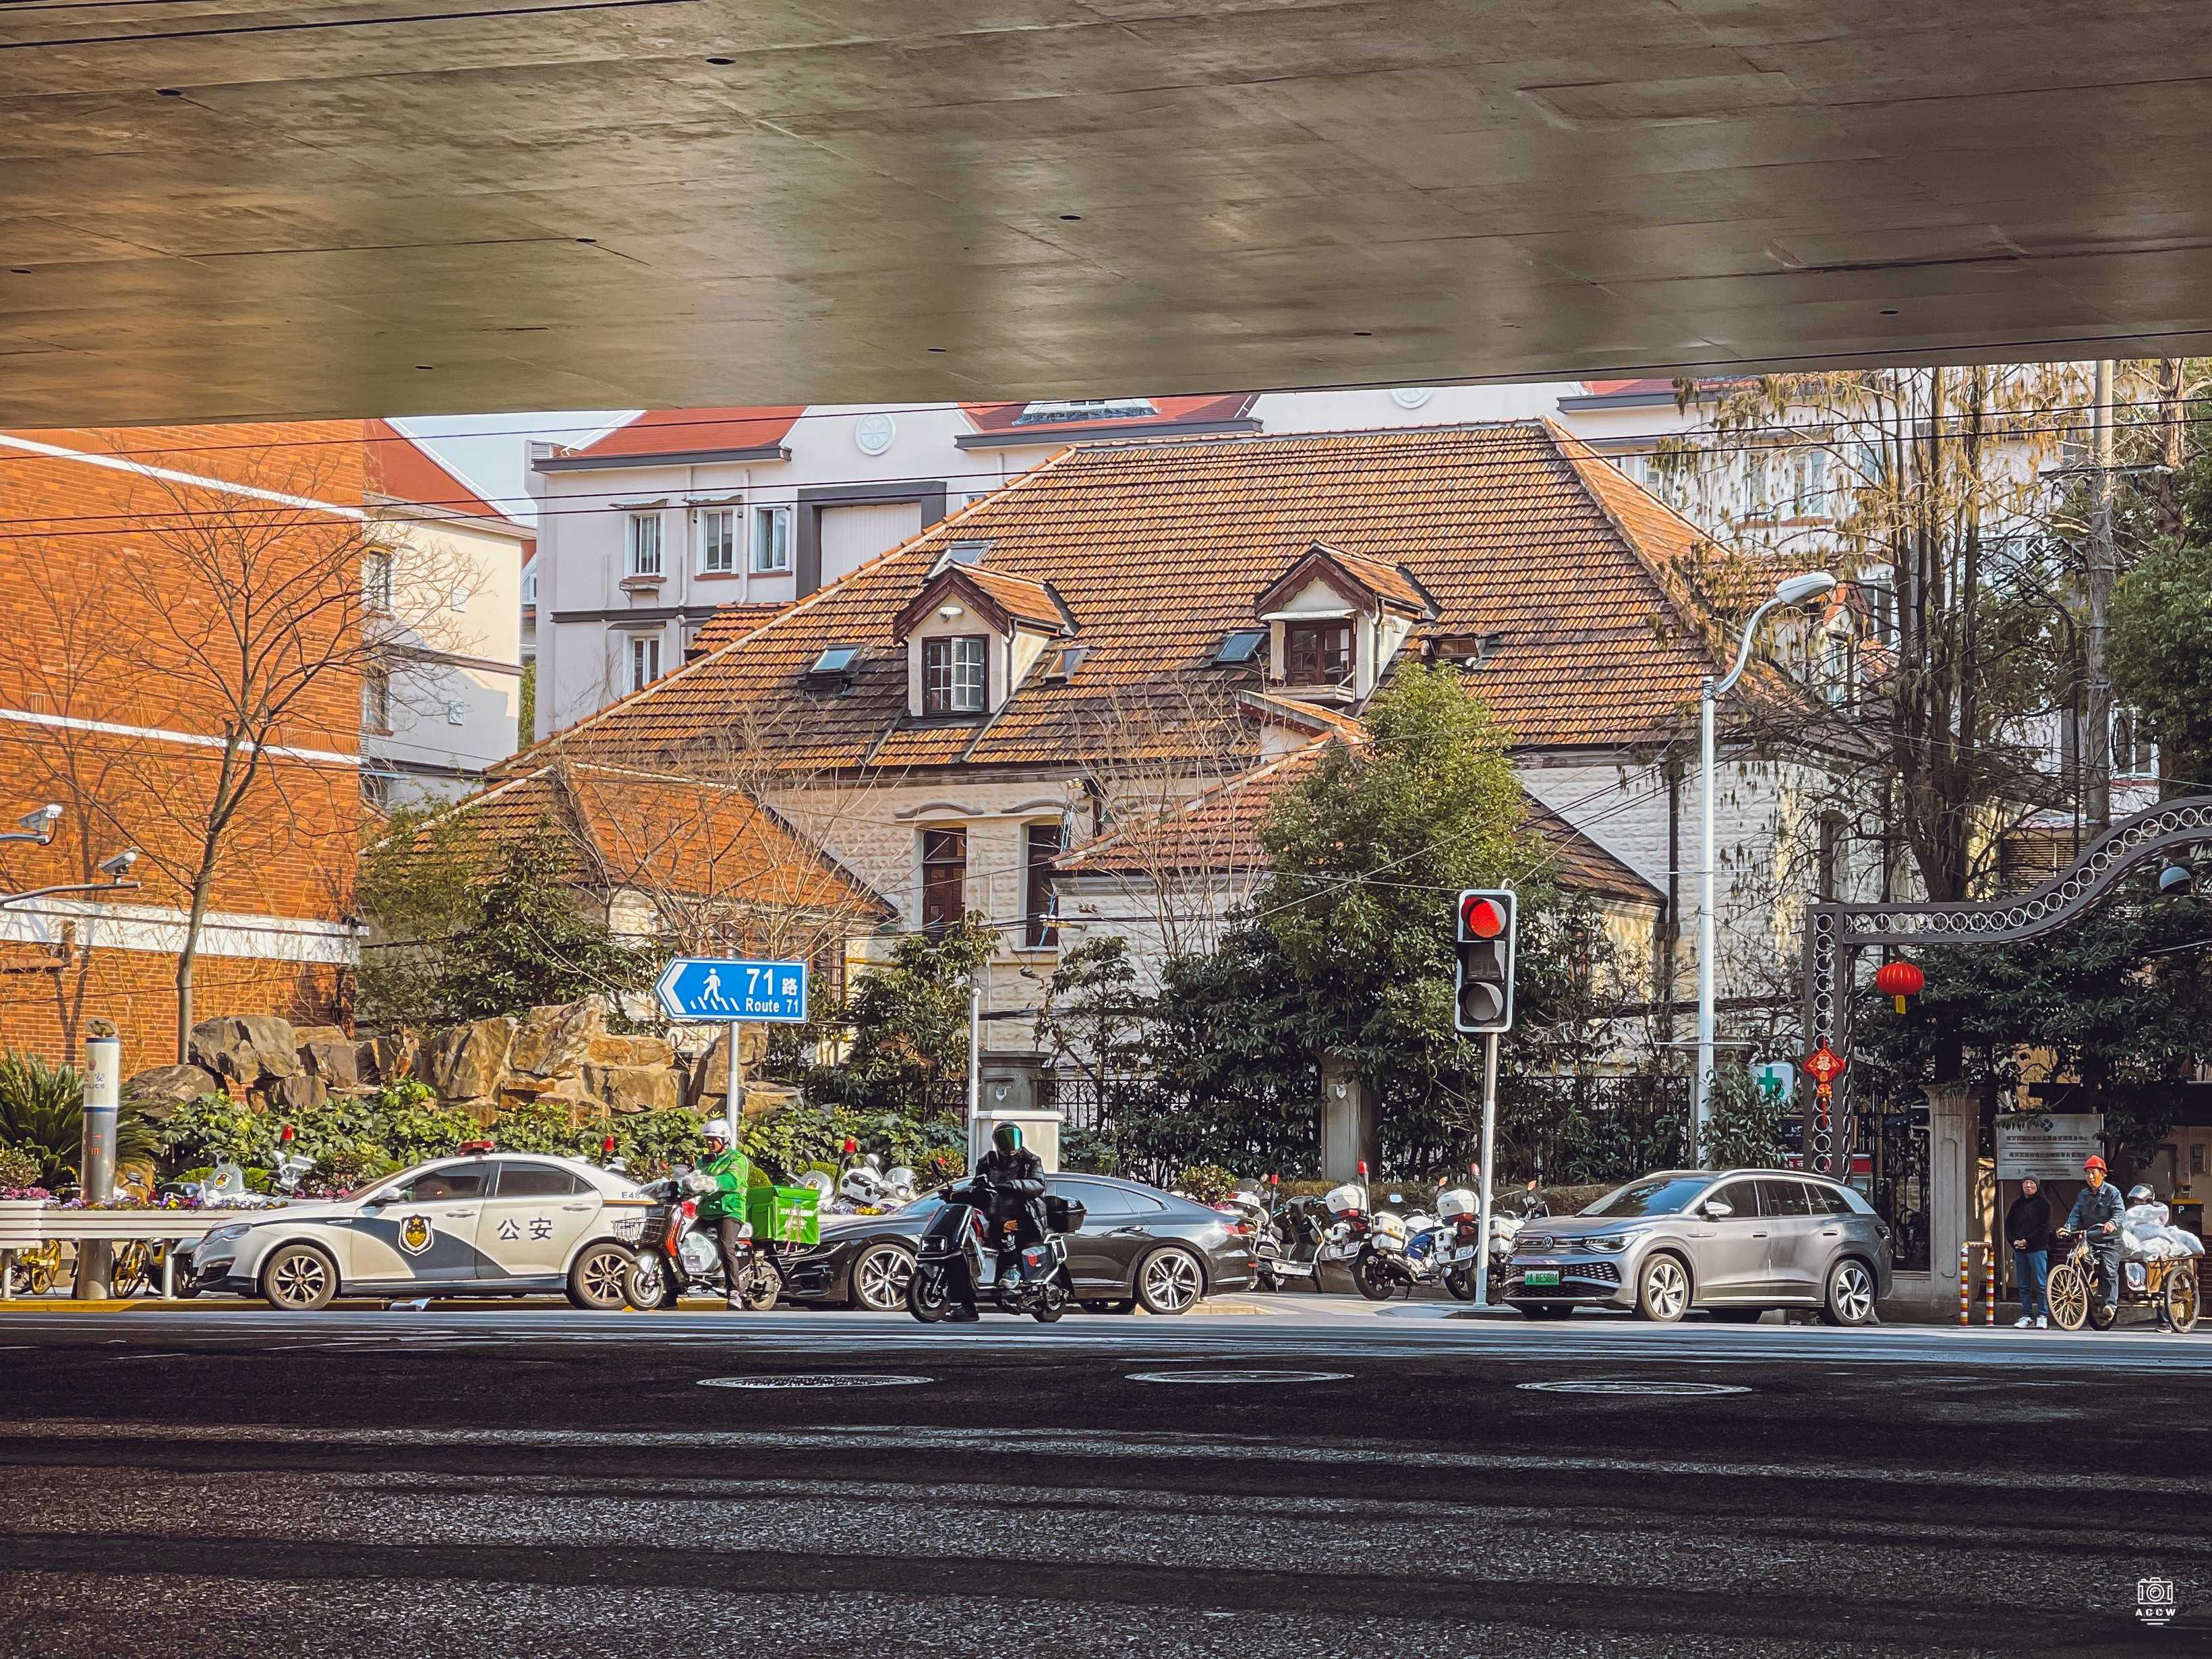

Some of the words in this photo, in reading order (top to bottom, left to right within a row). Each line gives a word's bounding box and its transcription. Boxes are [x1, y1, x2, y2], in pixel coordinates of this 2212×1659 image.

[745, 997, 780, 1013] Route
[786, 999, 798, 1014] 71
[2178, 1206, 2185, 1214] P
[496, 1217, 553, 1241] 公安
